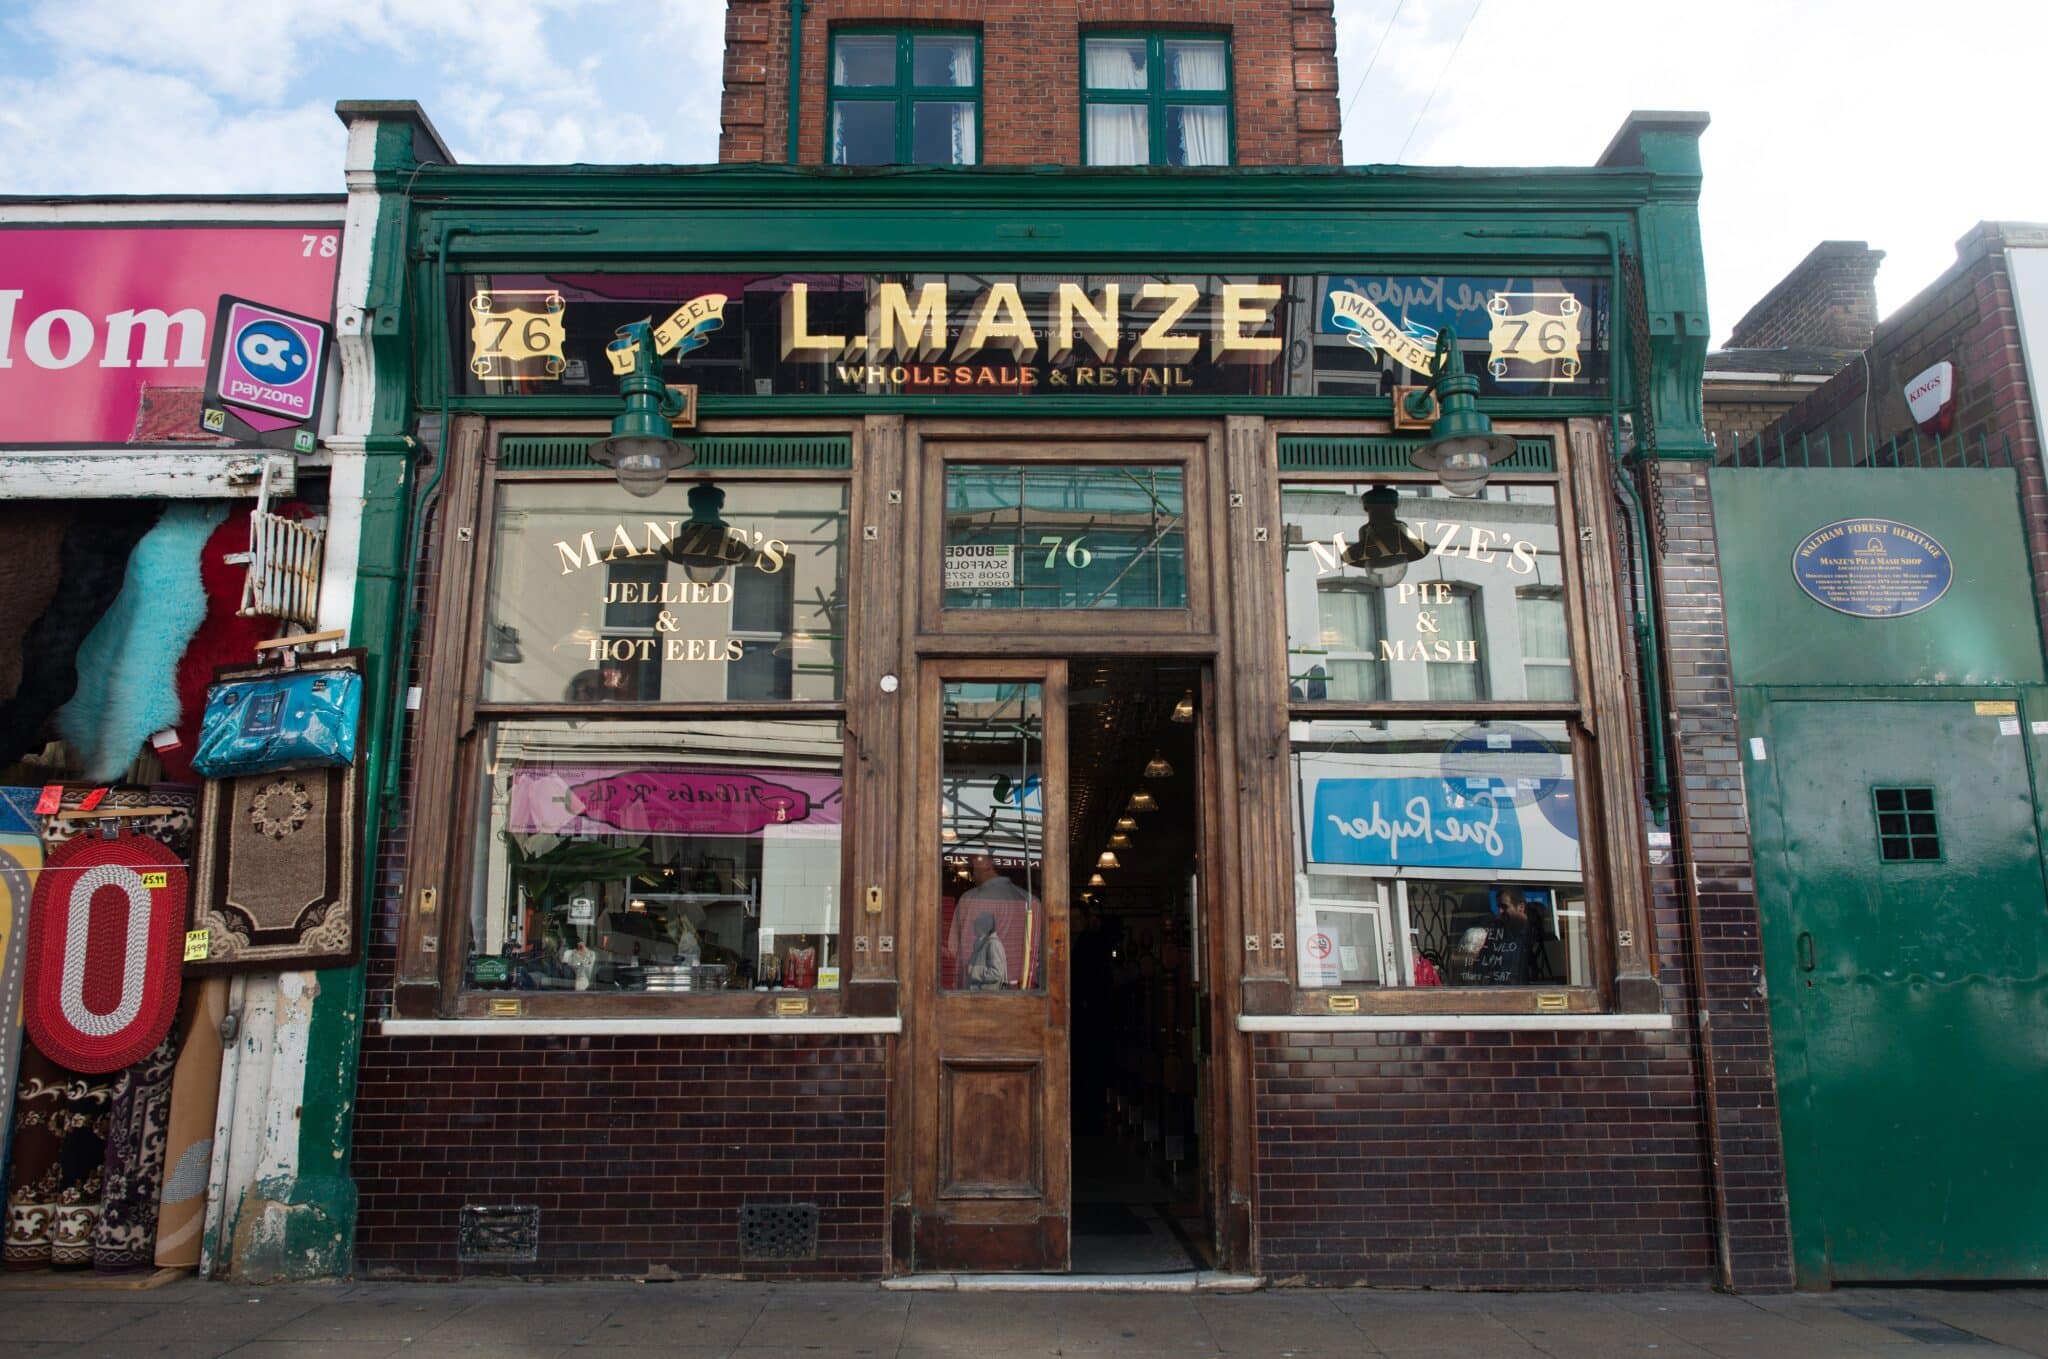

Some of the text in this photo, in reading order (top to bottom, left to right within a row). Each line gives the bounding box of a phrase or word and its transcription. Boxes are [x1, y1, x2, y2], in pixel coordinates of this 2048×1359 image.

[300, 234, 338, 257] 78
[483, 316, 552, 354] 76
[617, 298, 719, 369] LE EEL
[1499, 319, 1568, 355] 76
[837, 365, 1194, 387] WHOLESALE & RETAIL
[230, 379, 305, 408] payzone
[1909, 375, 1942, 403] KINGS
[553, 520, 790, 576] MANZE'S
[1039, 535, 1093, 570] 76
[1800, 523, 1942, 559] WALTHAM FOREST HERITAGE
[603, 581, 734, 605] JELLIED
[1398, 583, 1453, 605] PIE
[655, 610, 681, 632] &
[1415, 611, 1441, 633] &
[587, 638, 744, 662] HOT EELS
[1379, 639, 1479, 663] MASH
[188, 931, 207, 941] SALE
